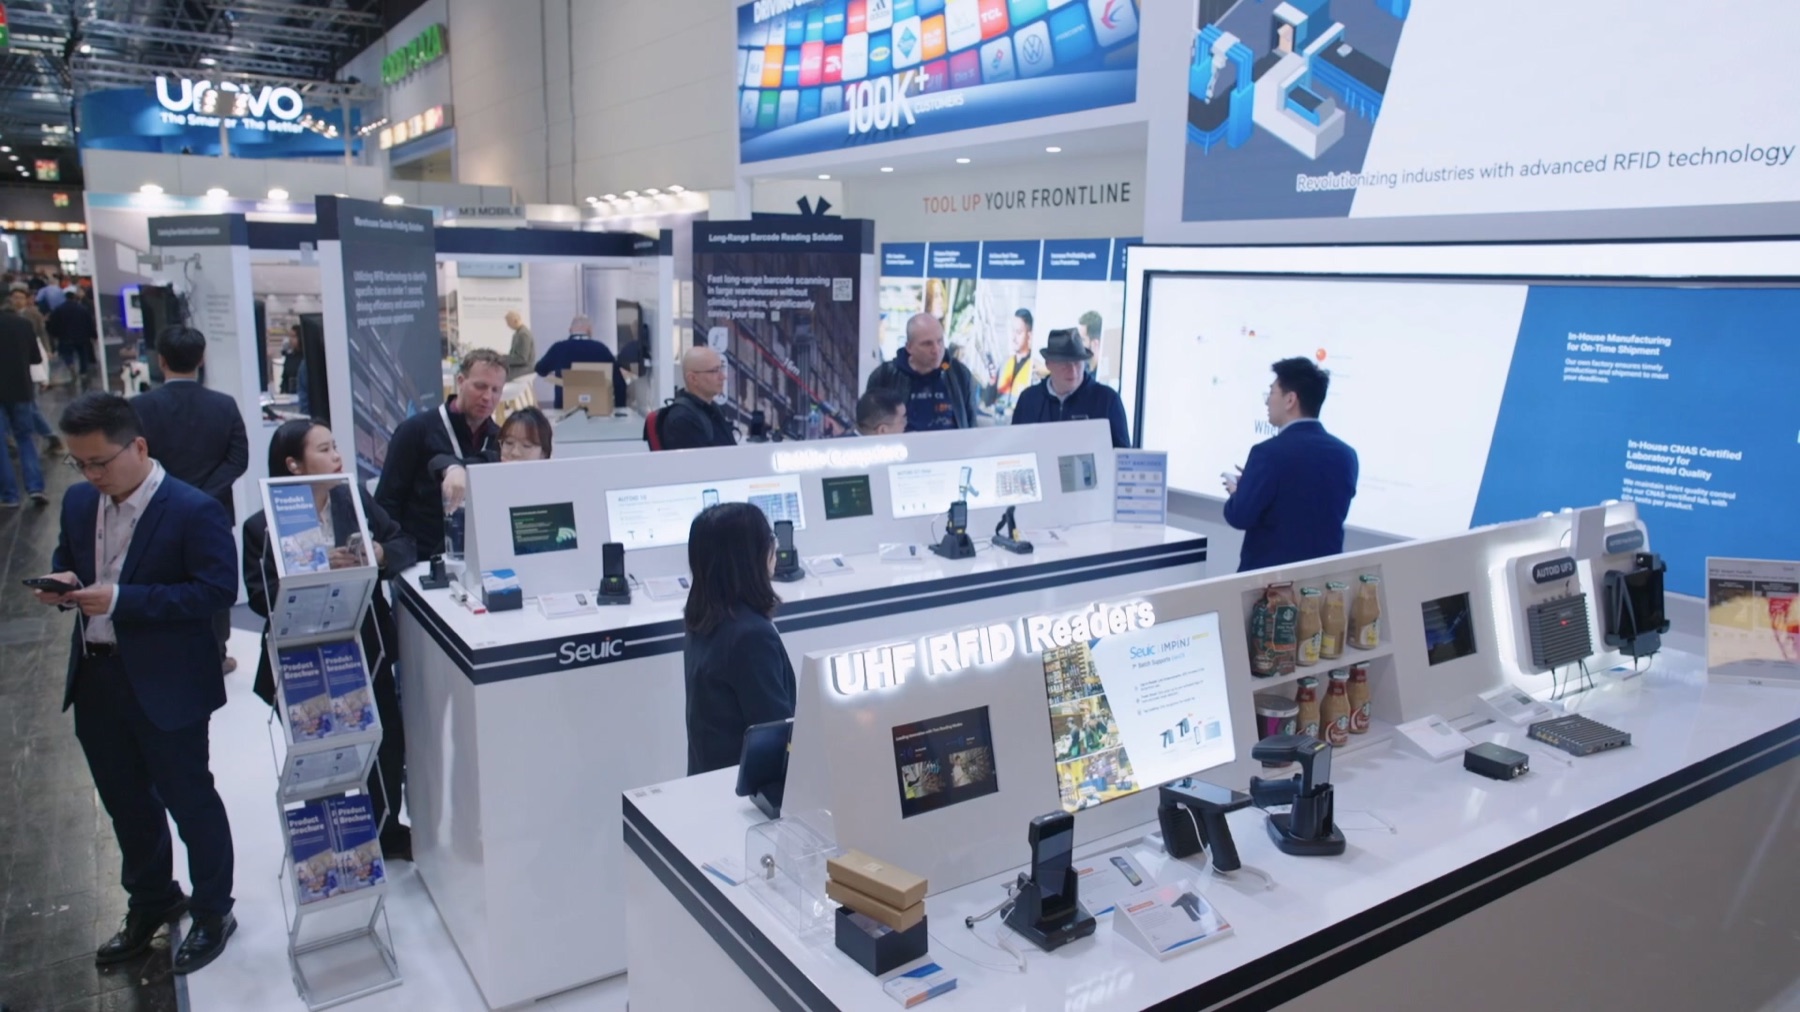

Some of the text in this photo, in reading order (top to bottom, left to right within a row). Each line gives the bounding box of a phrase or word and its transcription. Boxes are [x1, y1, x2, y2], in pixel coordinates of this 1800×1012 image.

[1296, 144, 1795, 192] Revolutionizing industries with advanced RFID technology
[924, 182, 1130, 214] TOOL UP YOUR FRONTLINE
[478, 207, 522, 217] MOBILE
[708, 233, 843, 243] Long-Range Barcode Reading Solution
[707, 274, 830, 287] Fast long-range barcode scanning
[716, 287, 733, 296] large
[735, 287, 778, 296] warehouses
[780, 288, 808, 296] without
[707, 298, 737, 308] climbing
[770, 299, 815, 311] significantly
[732, 311, 747, 320] your
[748, 311, 766, 319] time
[1568, 332, 1672, 347] In-House Manufacturing
[1567, 342, 1660, 356] for On-Time Shipment
[1591, 360, 1614, 368] factory
[1641, 363, 1663, 372] timely
[1578, 375, 1609, 383] deadlines.
[1598, 368, 1611, 376] and
[1612, 369, 1642, 378] shipment
[1628, 440, 1742, 461] In-House CNAS Certified
[1627, 450, 1691, 466] Laboratory for
[1626, 461, 1712, 481] Guaranteed Quality
[1623, 478, 1736, 500] We maintain strict quality control
[274, 496, 304, 504] Produkt
[1635, 496, 1652, 504] tests
[1652, 498, 1664, 506] per
[1665, 500, 1694, 511] product.
[1711, 498, 1727, 508] with
[1536, 565, 1559, 579] AUTOID
[559, 636, 622, 664] Seuic
[831, 600, 1155, 696] UHF RFID Readers
[1161, 637, 1190, 653] IMPINJ
[325, 655, 353, 664] Produkt
[283, 662, 313, 672] Product
[284, 669, 319, 680] Brochure
[338, 806, 366, 815] Product
[289, 816, 319, 827] Product
[340, 814, 371, 824] Brochure
[290, 824, 324, 835] Brochure
